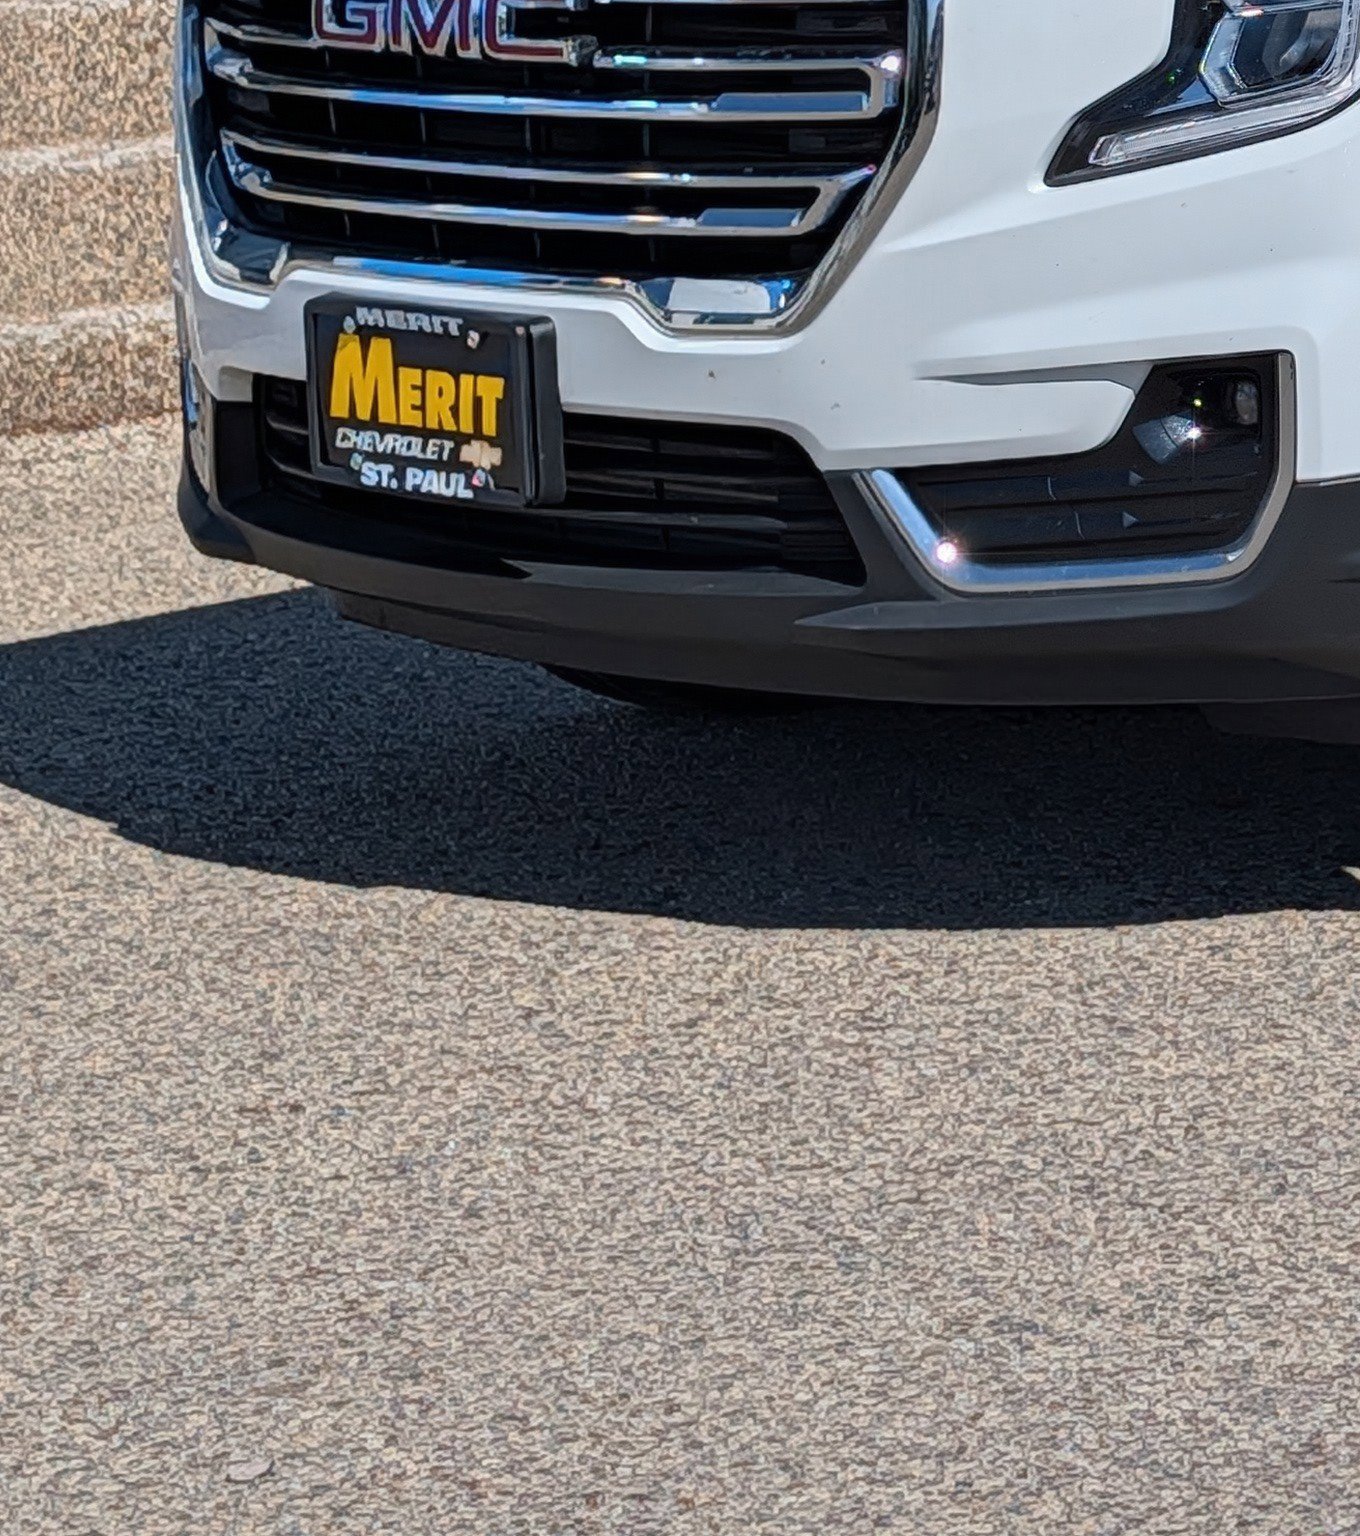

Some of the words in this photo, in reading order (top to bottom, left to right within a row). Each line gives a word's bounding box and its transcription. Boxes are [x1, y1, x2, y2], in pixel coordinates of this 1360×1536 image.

[355, 306, 464, 337] MERIT
[329, 332, 505, 438] MERIT
[335, 426, 455, 461] CHEVROLET
[359, 461, 398, 490] ST.
[404, 466, 475, 499] PAUL
